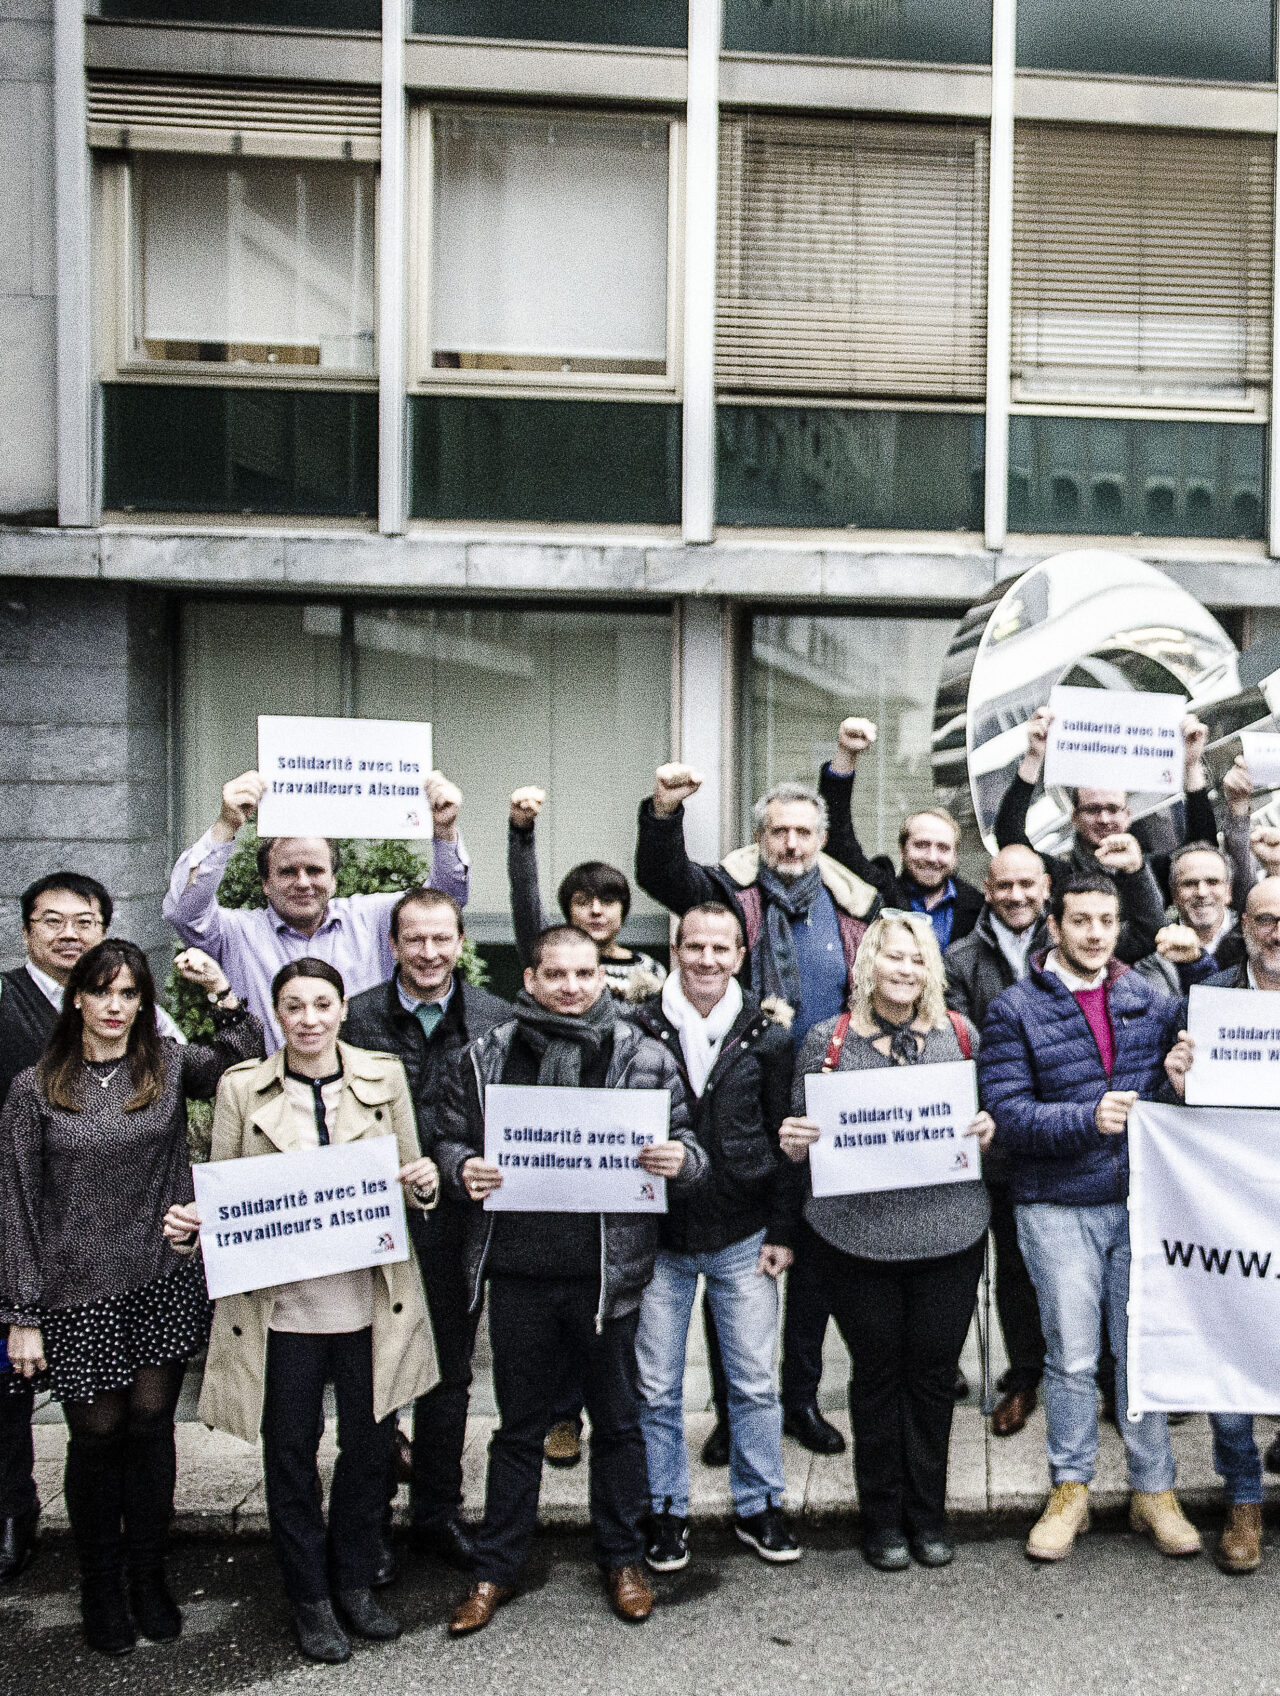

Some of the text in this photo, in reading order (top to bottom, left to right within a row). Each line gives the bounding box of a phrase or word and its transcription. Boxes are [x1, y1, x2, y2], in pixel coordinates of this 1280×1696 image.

[277, 755, 420, 773] Solidarité avec les
[272, 780, 420, 797] travailleurs Alstom
[1209, 1047, 1263, 1062] Alstom
[839, 1101, 952, 1126] Solidarity with
[502, 1126, 655, 1146] Solidarité avec les
[833, 1125, 955, 1149] Alstom Workers
[497, 1152, 643, 1170] travailleurs Alsto
[218, 1177, 388, 1221] Solidarité avec les
[215, 1203, 391, 1248] travailleurs Alstom
